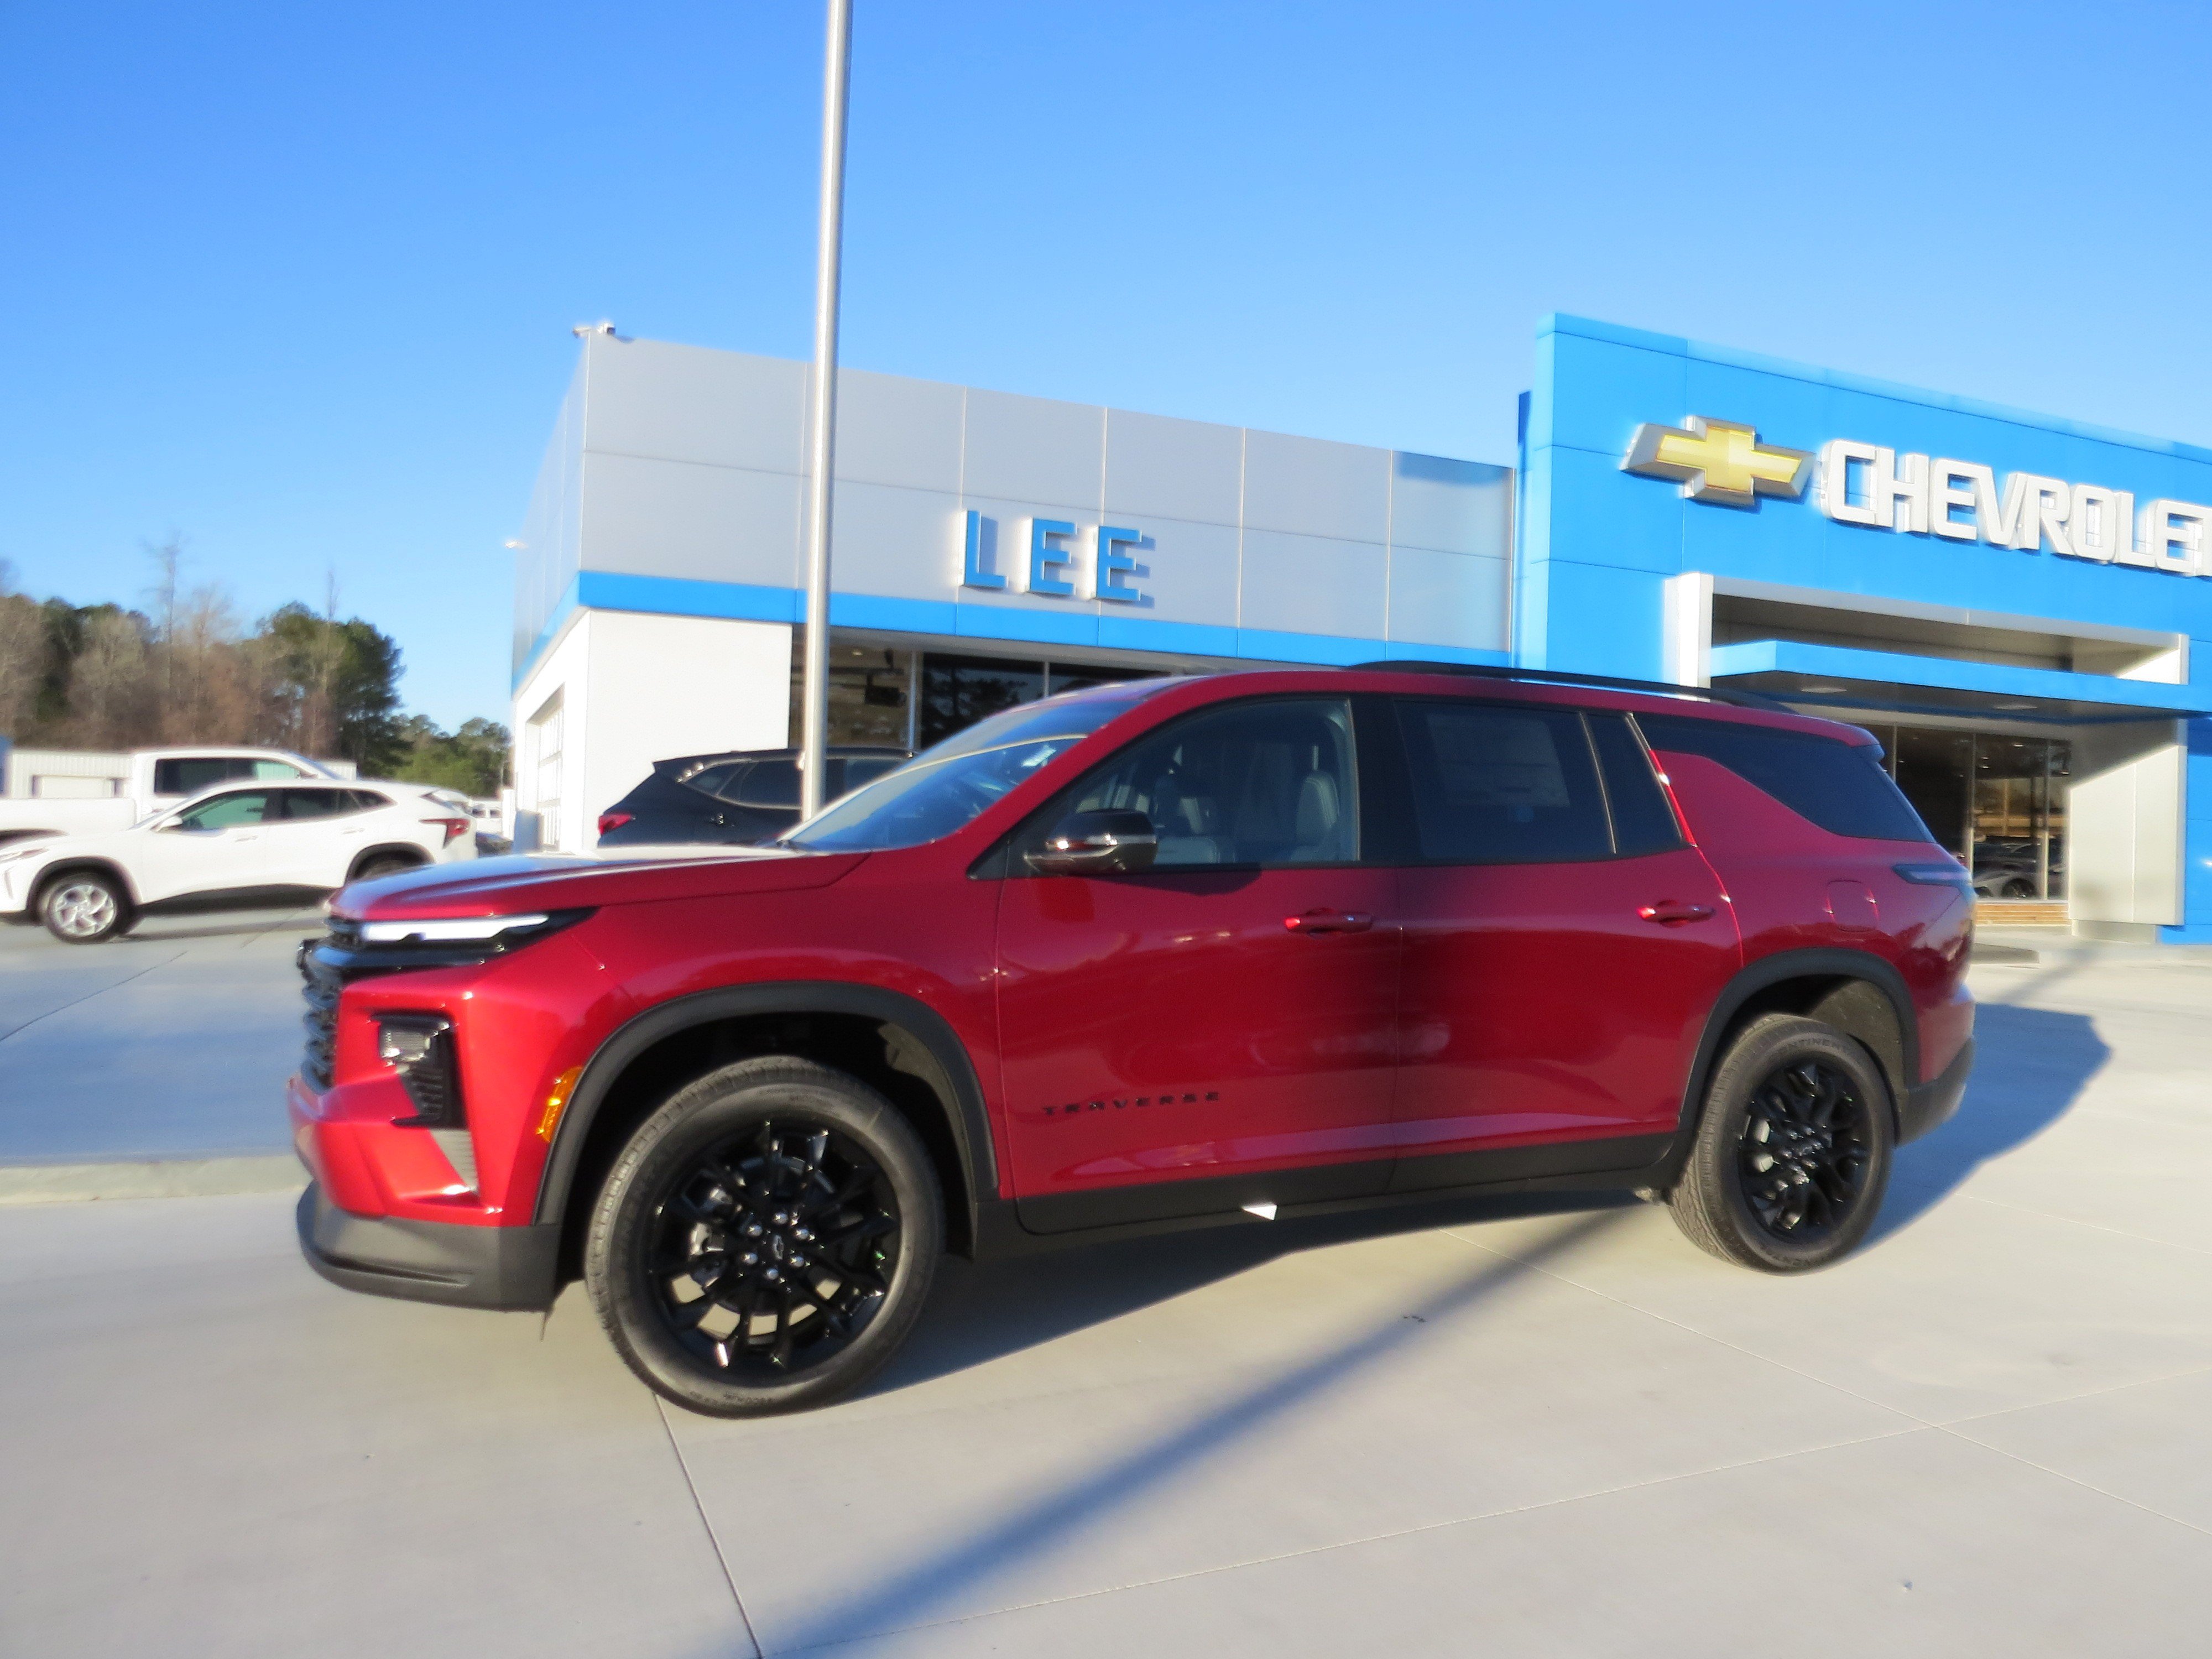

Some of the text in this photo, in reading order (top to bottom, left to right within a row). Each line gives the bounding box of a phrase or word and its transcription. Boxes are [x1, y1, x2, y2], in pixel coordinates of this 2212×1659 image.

[1817, 439, 2212, 577] CHEVROLE
[961, 509, 1141, 601] LEE
[1043, 1091, 1218, 1115] TRAVERSE
